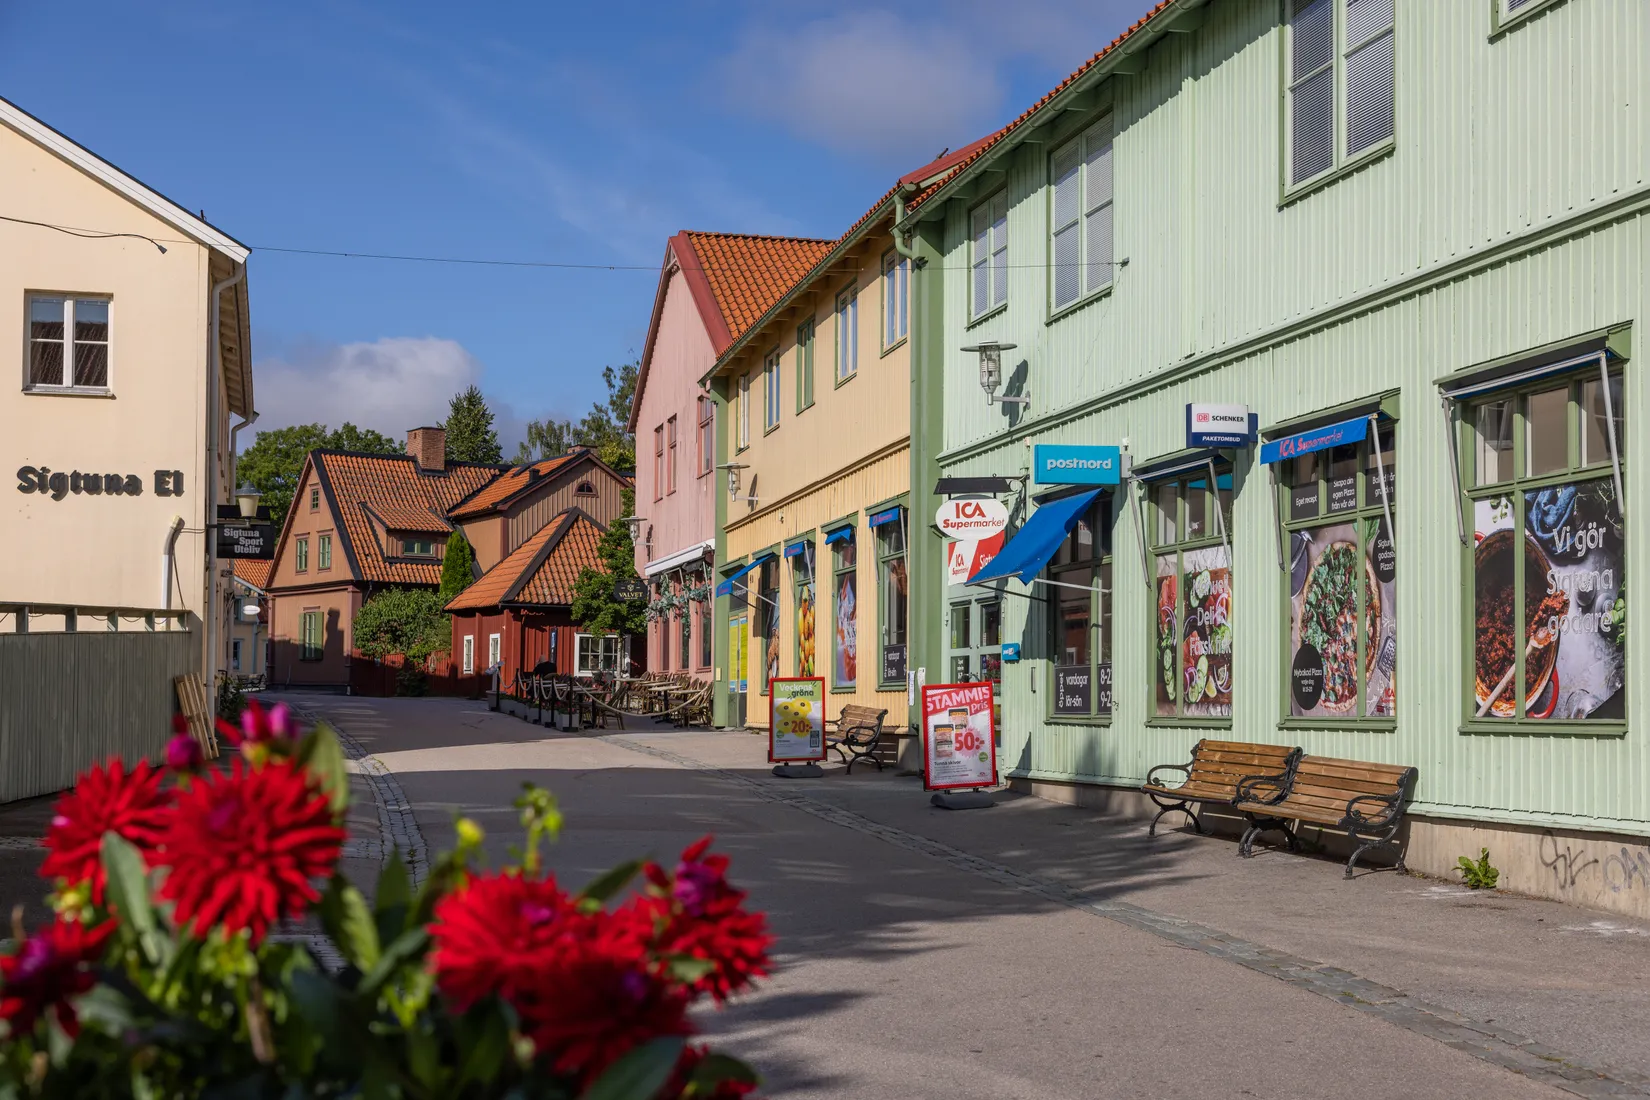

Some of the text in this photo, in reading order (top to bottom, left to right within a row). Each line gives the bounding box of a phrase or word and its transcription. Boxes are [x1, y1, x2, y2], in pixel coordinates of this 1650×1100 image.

[1198, 413, 1209, 422] DB
[1279, 429, 1343, 458] ICA Supermarket
[1047, 458, 1112, 471] postnord
[16, 466, 185, 501] Sigtuna El
[1305, 494, 1317, 504] recept
[1332, 488, 1355, 500] egen Pizza
[955, 502, 986, 519] ICA
[943, 517, 1004, 530] Supermarket
[224, 528, 259, 538] Sigtuna
[1553, 522, 1606, 557] Vi gör
[239, 537, 263, 546] Sport
[234, 545, 261, 553] Uteliv
[955, 553, 964, 567] ICA
[1546, 568, 1613, 599] Sigtuna
[1197, 606, 1214, 627] Deli
[1547, 607, 1613, 641] godare
[1190, 635, 1213, 656] Färsk
[1066, 673, 1088, 687] vardagar
[779, 683, 812, 691] Veckans
[792, 689, 814, 698] gröna
[926, 687, 990, 712] STAMMIS
[1066, 695, 1082, 707] lör-sön
[971, 700, 988, 713] Pris
